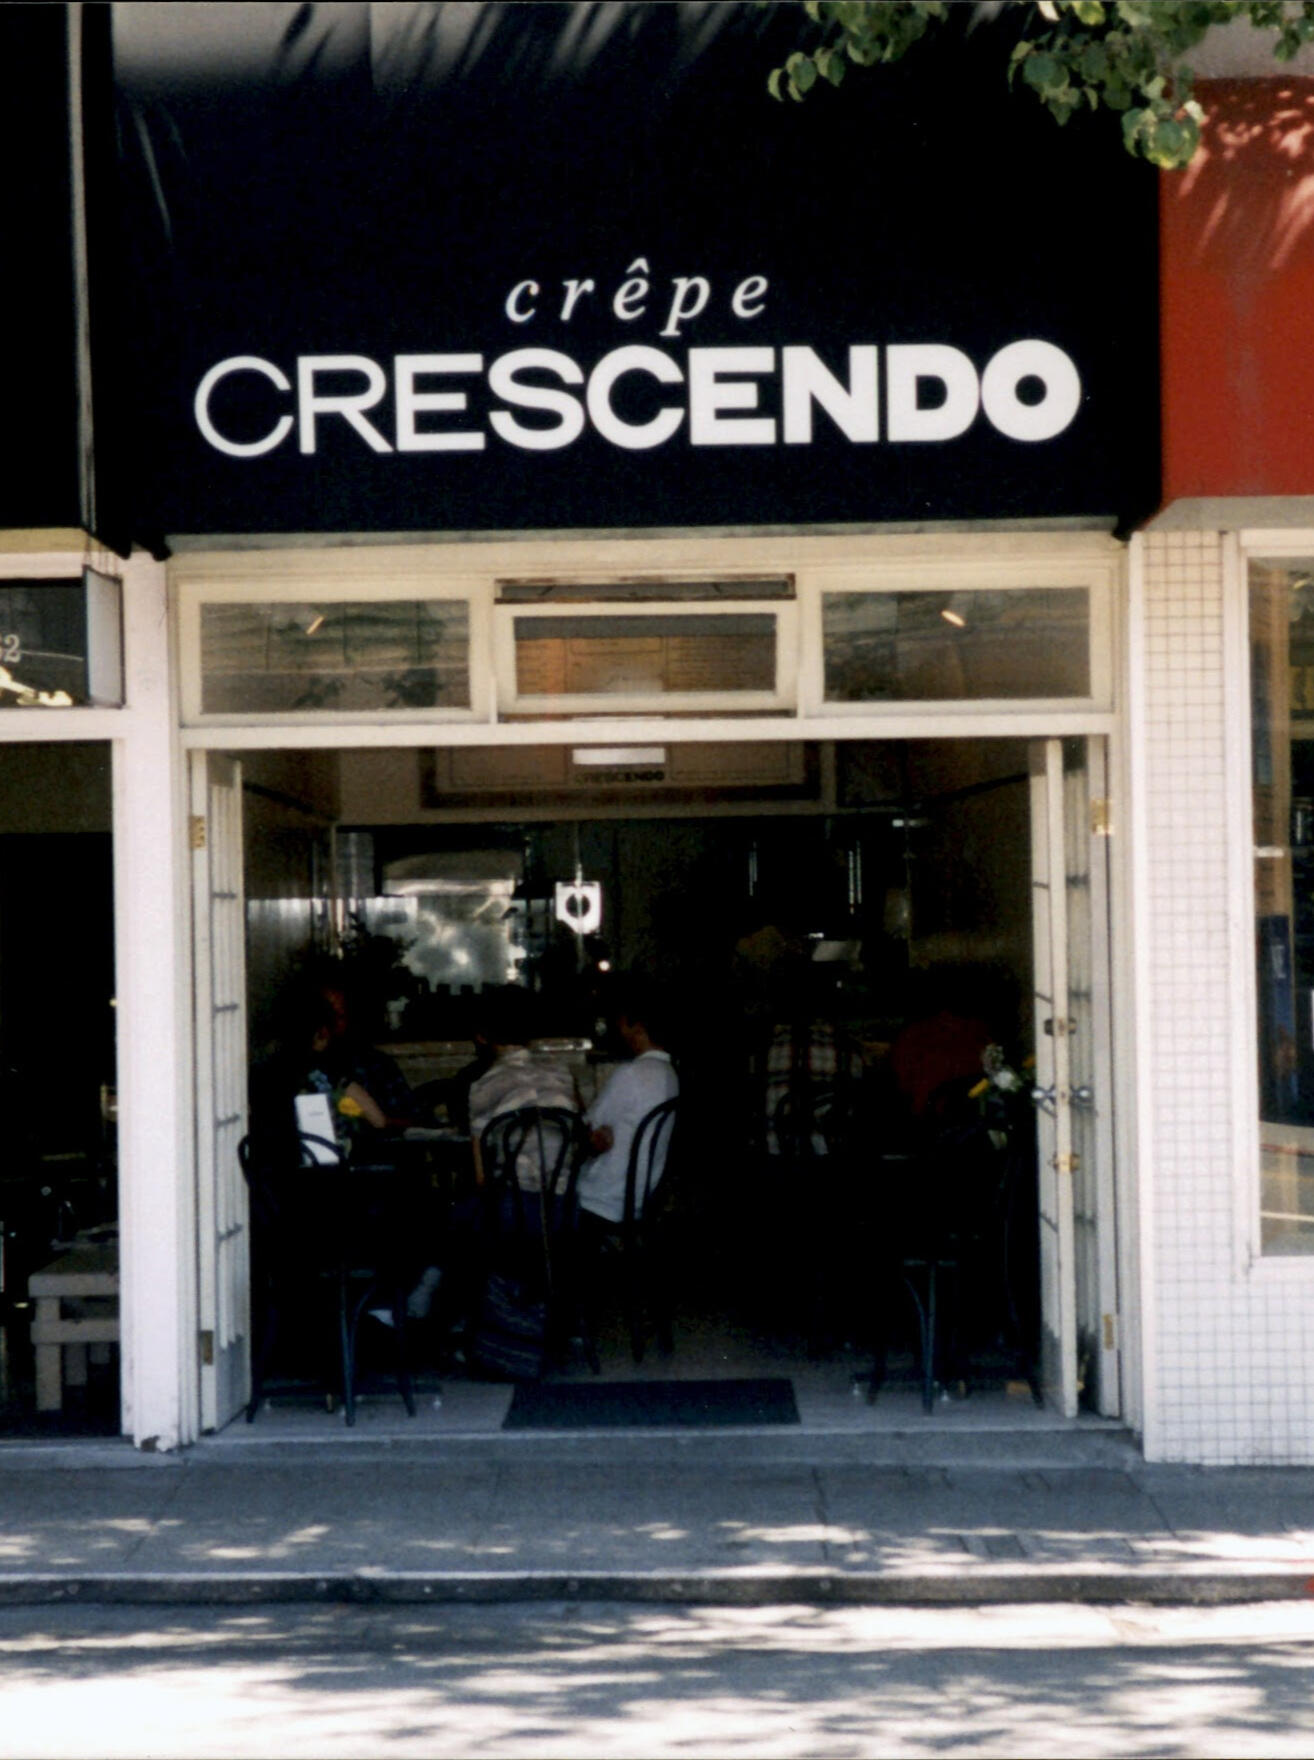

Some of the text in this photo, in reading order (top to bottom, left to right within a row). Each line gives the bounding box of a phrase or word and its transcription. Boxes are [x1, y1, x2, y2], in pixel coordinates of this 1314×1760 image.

[505, 257, 768, 337] crêpe
[194, 339, 1081, 458] CRESCENDO
[0, 633, 21, 663] 2
